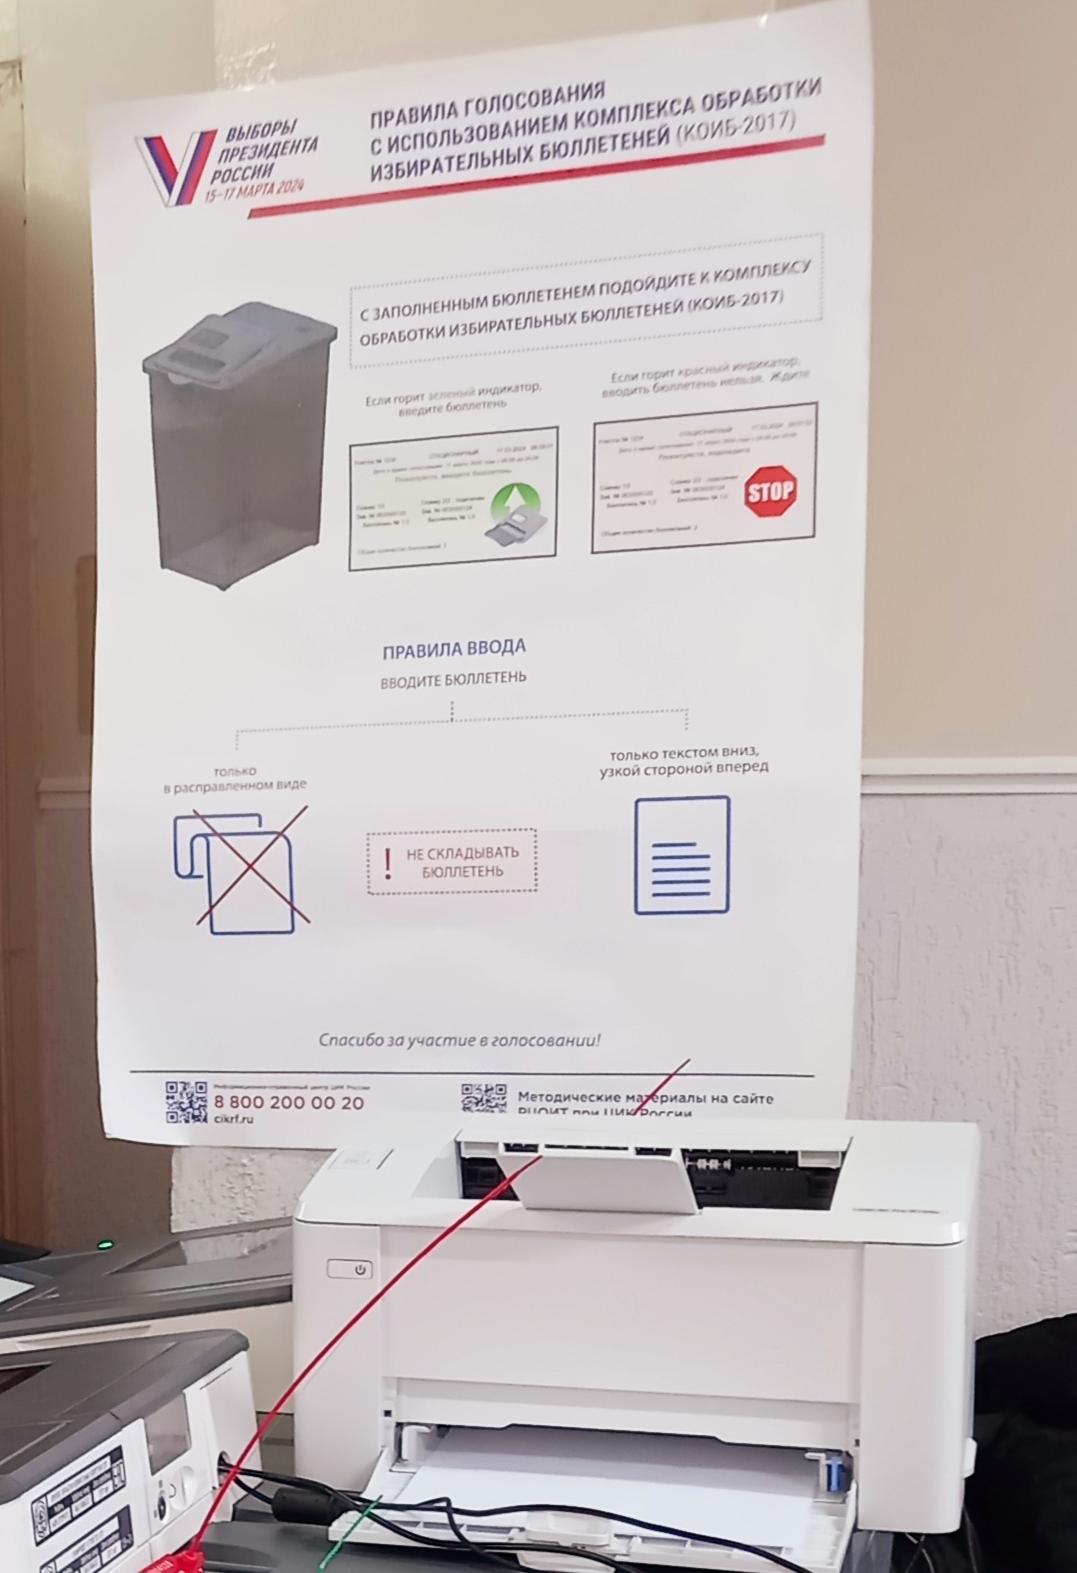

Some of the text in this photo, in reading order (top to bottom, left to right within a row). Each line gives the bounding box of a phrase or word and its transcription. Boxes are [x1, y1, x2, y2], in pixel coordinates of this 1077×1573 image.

[370, 80, 606, 130] ПРАВИЛА ГОЛОСОВАНИЯ
[371, 76, 823, 156] С ИСПОЛЬЗОВАНИЕМ КОМПЛЕКСА ОБРАБОТКИ
[225, 118, 298, 143] ВЫБОРЫ
[217, 136, 319, 164] ПРЕЗИДЕНТА
[370, 109, 797, 183] ИЗБИРАТЕЛЬНЫХ БЮЛЛЕТЕНЕЙ (КОИБ-2017)
[210, 162, 275, 185] РОССИИ
[238, 182, 275, 200] МАРТА
[276, 178, 305, 195] 2024
[360, 259, 812, 322] С ЗАПОЛНЕННЫМ БЮЛЛЕТЕНЕМ ПОДОЙДИТЕ К КОМПЛЕКСУ
[360, 289, 784, 347] ОБРАБОТКИ ИЗБИРАТЕЛЬНЫХ БЮЛЛЕТЕНЕЙ (КОИБ-2017)
[611, 356, 800, 384] Если горит красный индикатор,
[366, 382, 543, 407] Если горит зеленый индикатор,
[602, 385, 650, 399] вводить
[652, 380, 716, 394] бюллетень
[770, 369, 810, 384] Ждите
[398, 399, 507, 417] введите бюллетень
[748, 480, 795, 503] STOP
[383, 638, 527, 660] ПРАВИЛА ВВОДА
[380, 670, 527, 690] ВВОДИТЕ БЮЛЛЕТЕНЬ
[610, 746, 760, 762] только текстом вниз,
[213, 767, 257, 778] только
[600, 761, 769, 781] узкой стороной вперед
[163, 779, 308, 796] в расправленном виде
[407, 846, 520, 862] НЕ СКЛАДЫВАТЬ
[422, 865, 504, 879] БЮЛЛЕТЕНЬ
[319, 1032, 601, 1050] Спасибо за участие в голосовании!
[214, 1095, 365, 1110] 8 800 200 00 20
[518, 1091, 621, 1104] Методические
[711, 1094, 728, 1104] на
[733, 1092, 774, 1105] сайте
[214, 1114, 254, 1124] cikrf.ru
